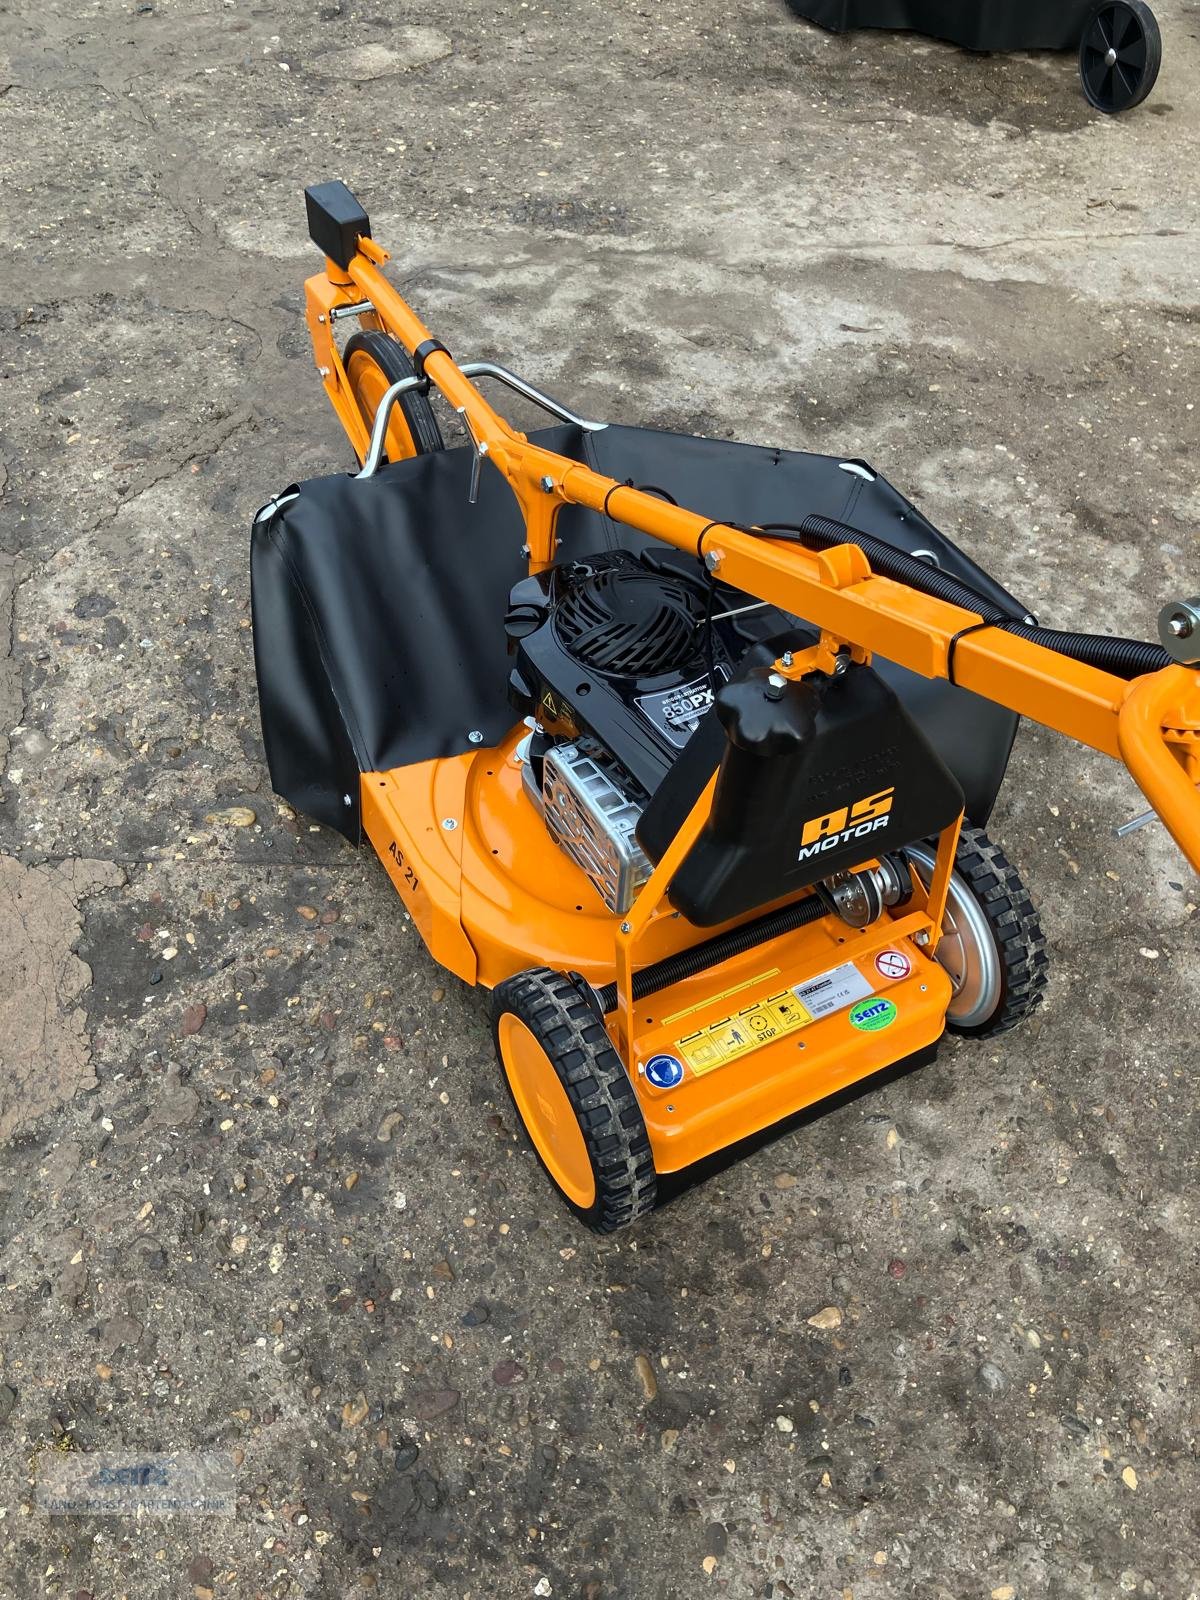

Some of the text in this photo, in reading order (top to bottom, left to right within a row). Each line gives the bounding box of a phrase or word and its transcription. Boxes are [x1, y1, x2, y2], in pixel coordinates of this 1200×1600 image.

[662, 689, 715, 718] 850PX
[801, 786, 895, 847] AS
[798, 815, 890, 861] MOTOR
[388, 841, 419, 892] AS 21
[854, 1002, 889, 1022] SEITZ
[757, 1028, 777, 1042] STOP
